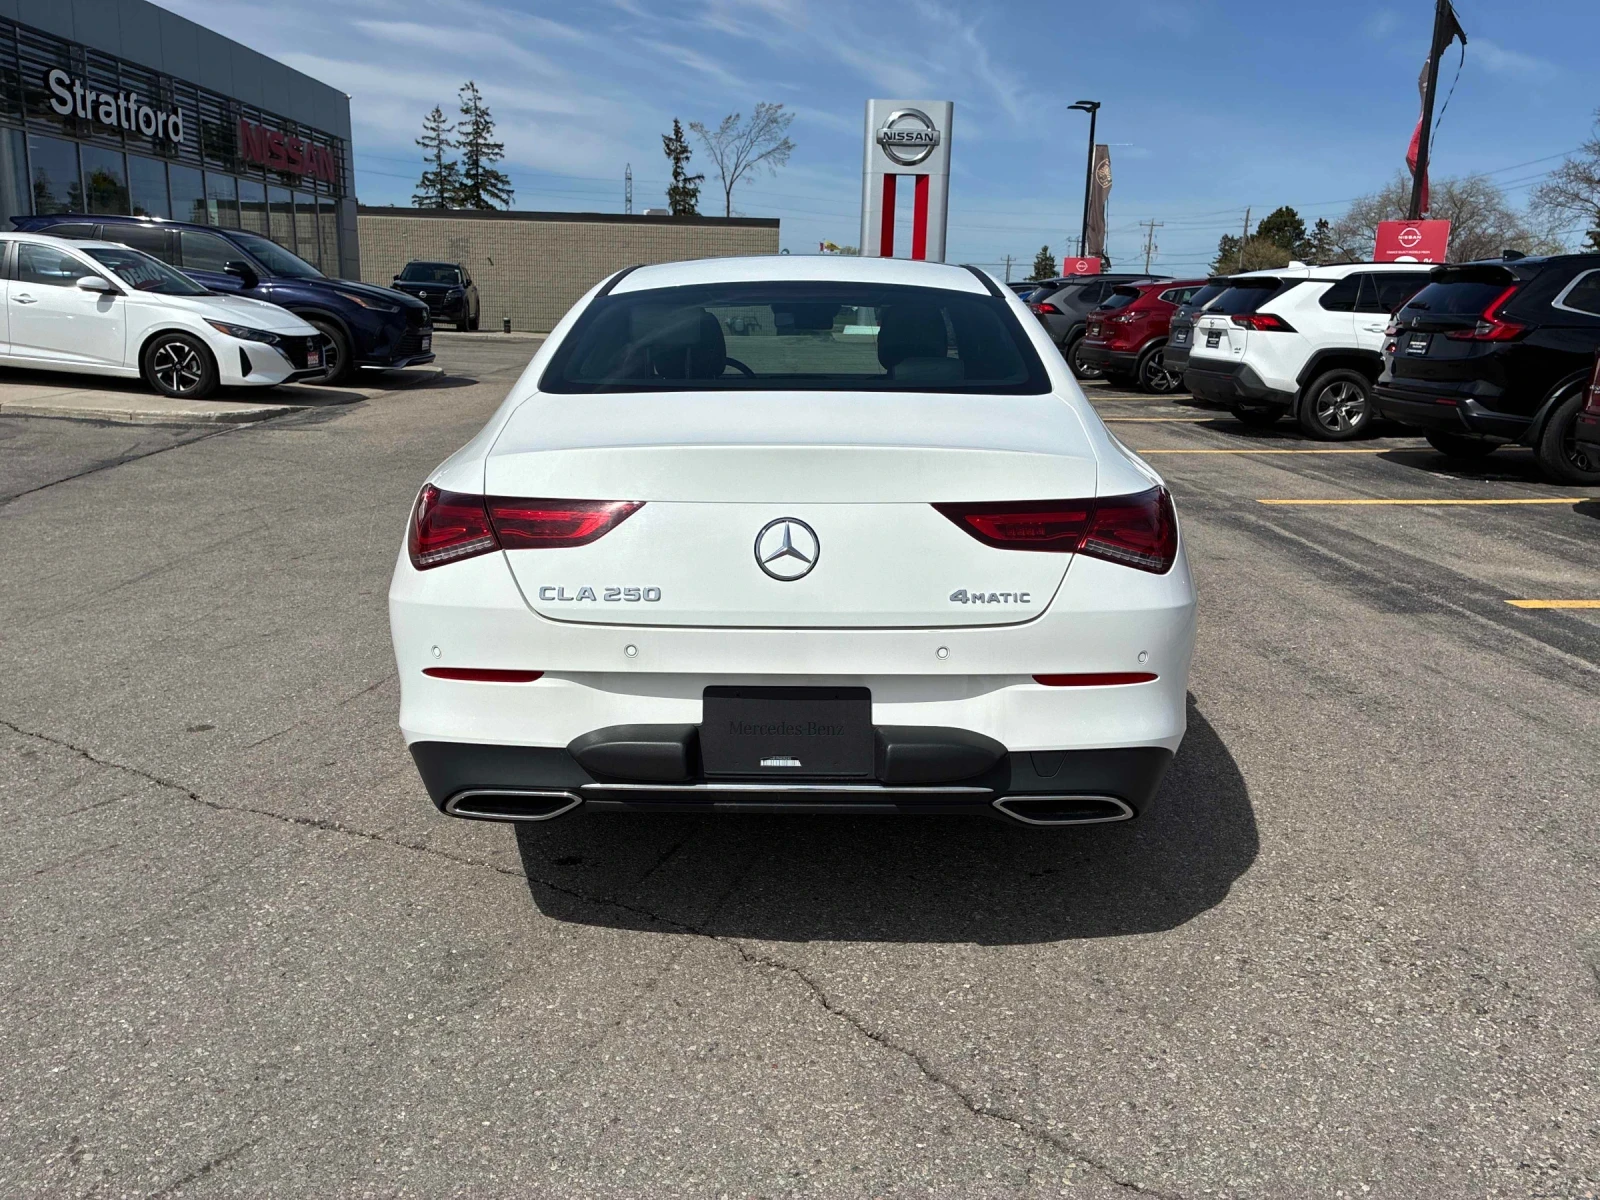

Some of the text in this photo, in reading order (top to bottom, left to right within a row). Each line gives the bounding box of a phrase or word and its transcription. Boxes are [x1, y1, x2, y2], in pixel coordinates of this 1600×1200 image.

[49, 69, 183, 142] Stratford
[883, 131, 934, 142] NISSAN
[238, 118, 335, 183] NISSAN
[539, 586, 661, 602] CLA 250
[949, 589, 1031, 604] 4MATIC
[729, 720, 845, 737] Mercedes-Benz
